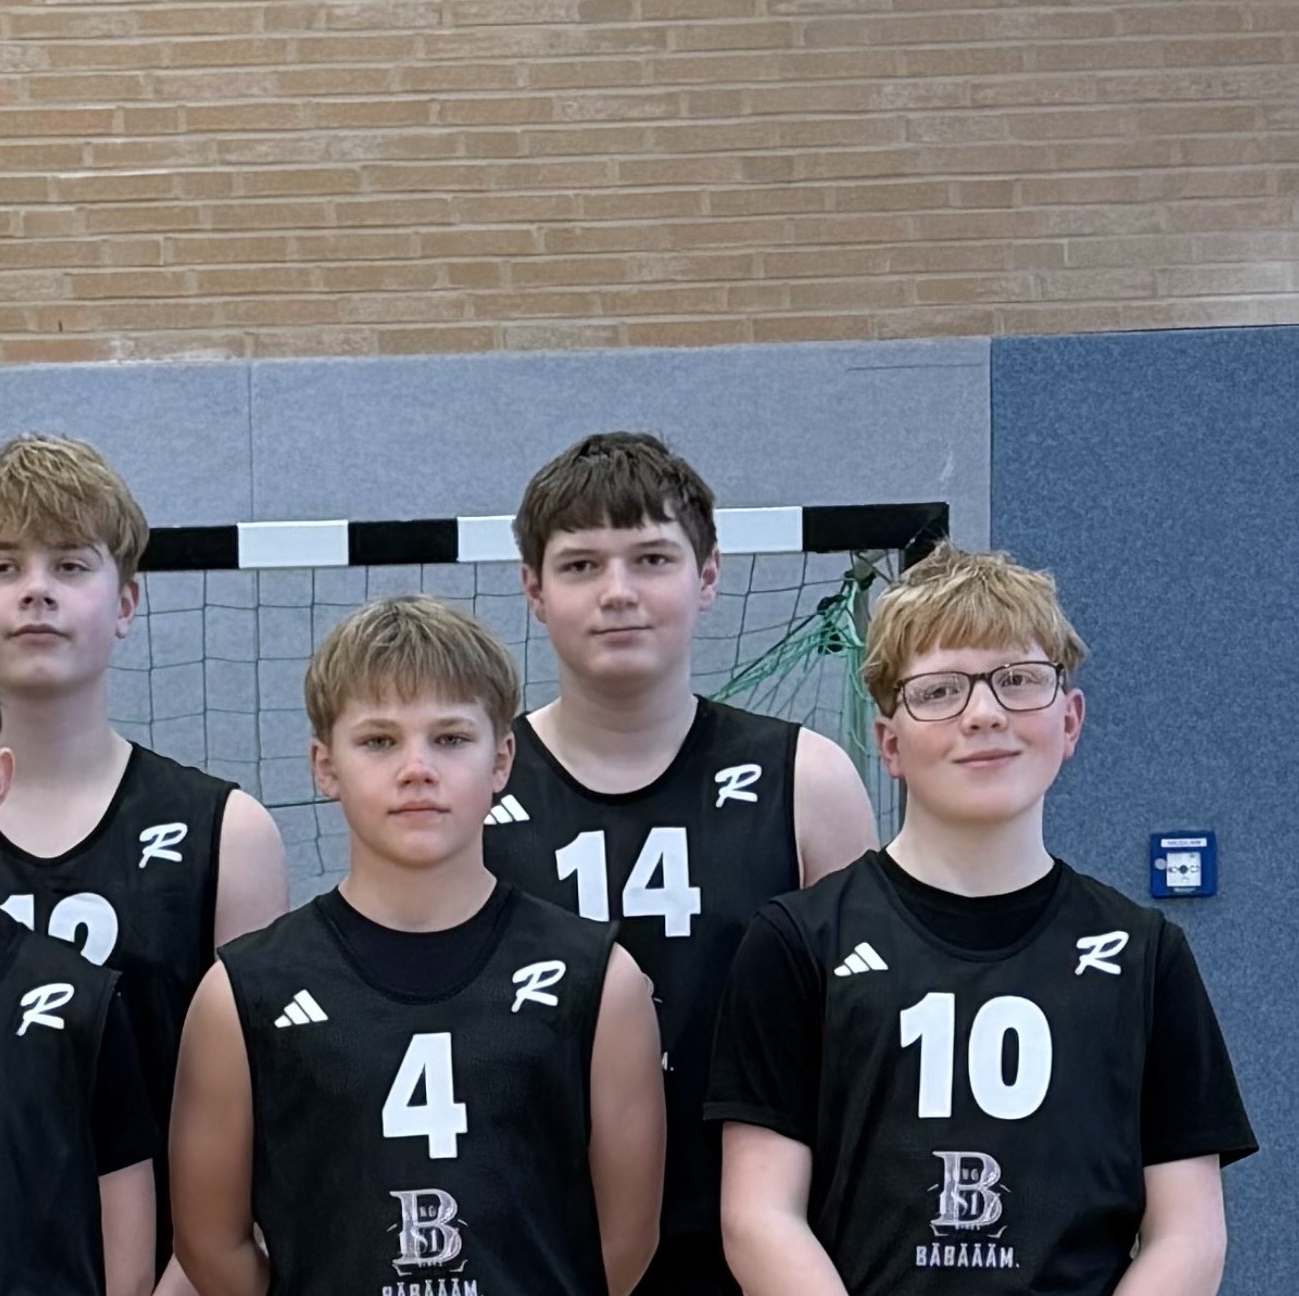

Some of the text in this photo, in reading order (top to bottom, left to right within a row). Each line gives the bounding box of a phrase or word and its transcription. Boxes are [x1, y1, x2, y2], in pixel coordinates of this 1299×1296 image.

[715, 764, 761, 807] R
[139, 823, 187, 868] R
[556, 827, 700, 937] 14
[1075, 931, 1128, 975] R
[17, 983, 74, 1035] R
[512, 961, 566, 1012] R
[900, 993, 1052, 1119] 10
[382, 1032, 467, 1158] 4
